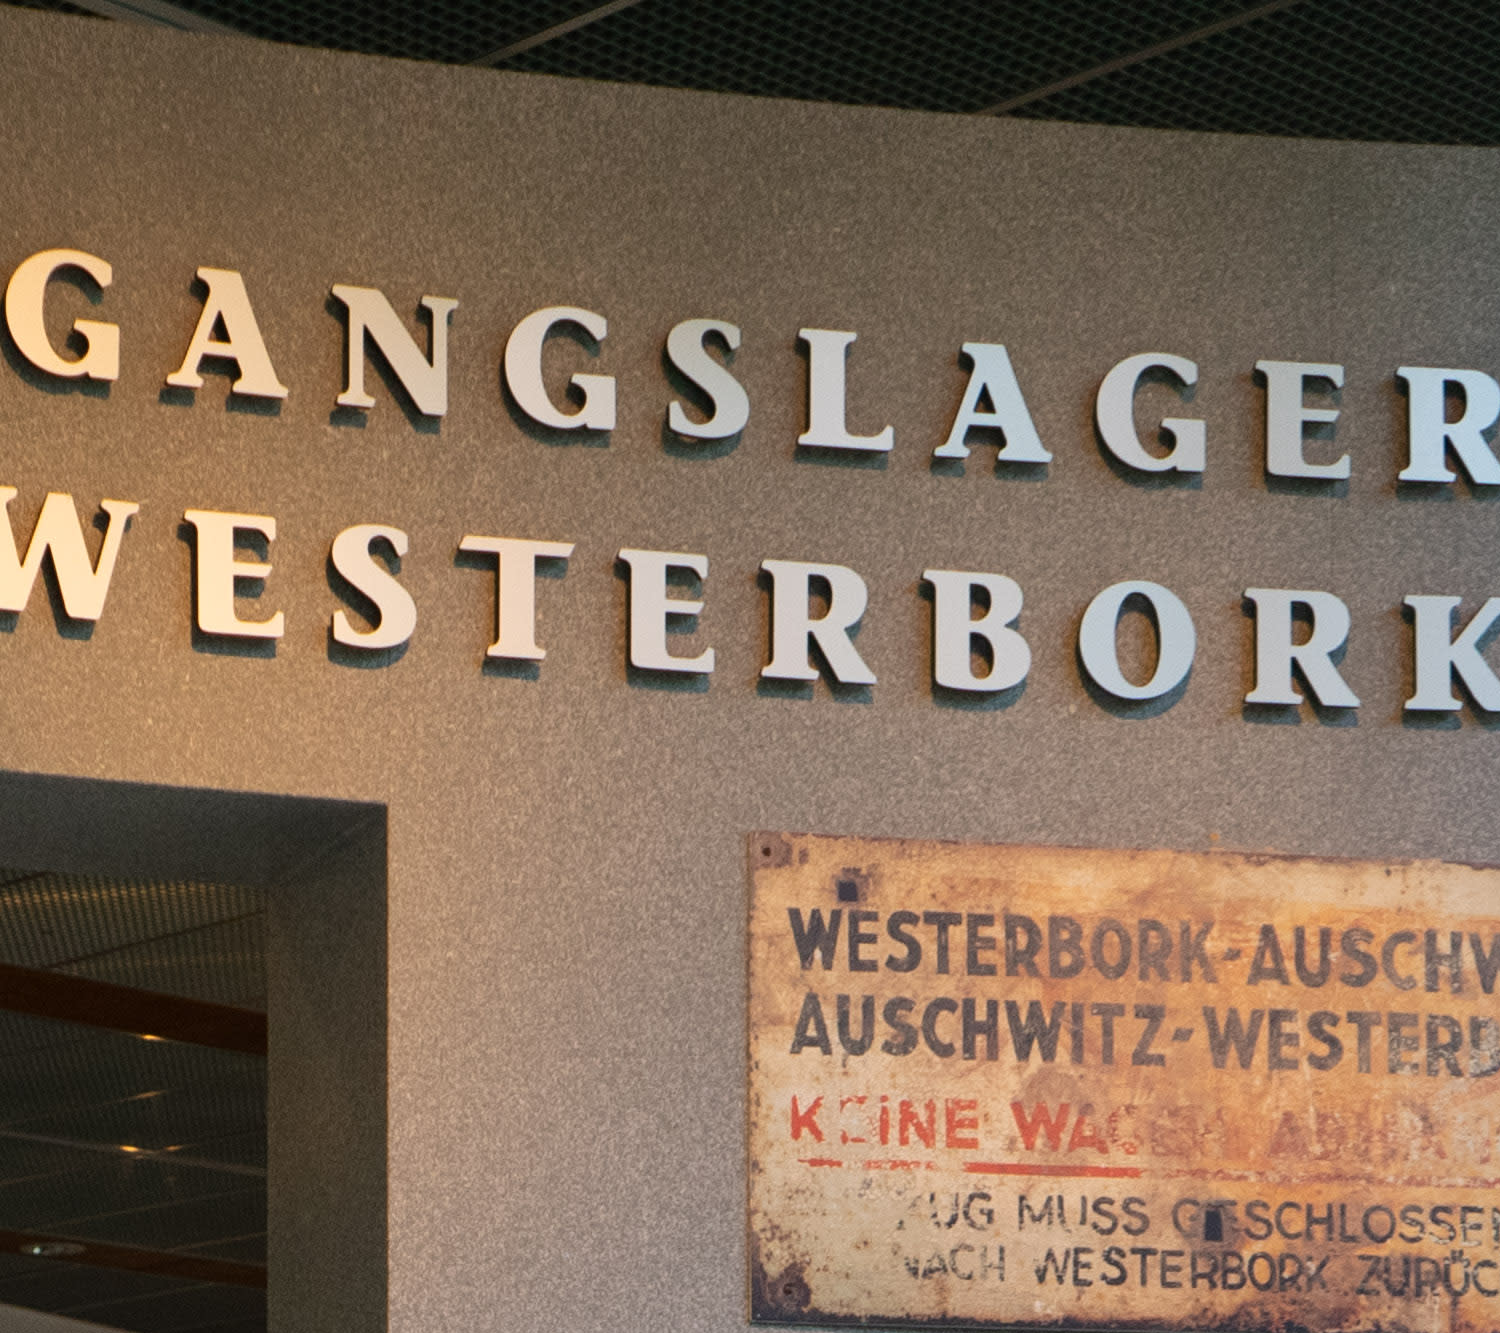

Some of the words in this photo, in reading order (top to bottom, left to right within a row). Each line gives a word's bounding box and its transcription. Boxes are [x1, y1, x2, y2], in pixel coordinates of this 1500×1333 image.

[896, 1190, 996, 1232] UG
[1018, 1194, 1150, 1237] MUSS
[1034, 1246, 1331, 1294] WESTERBORK
